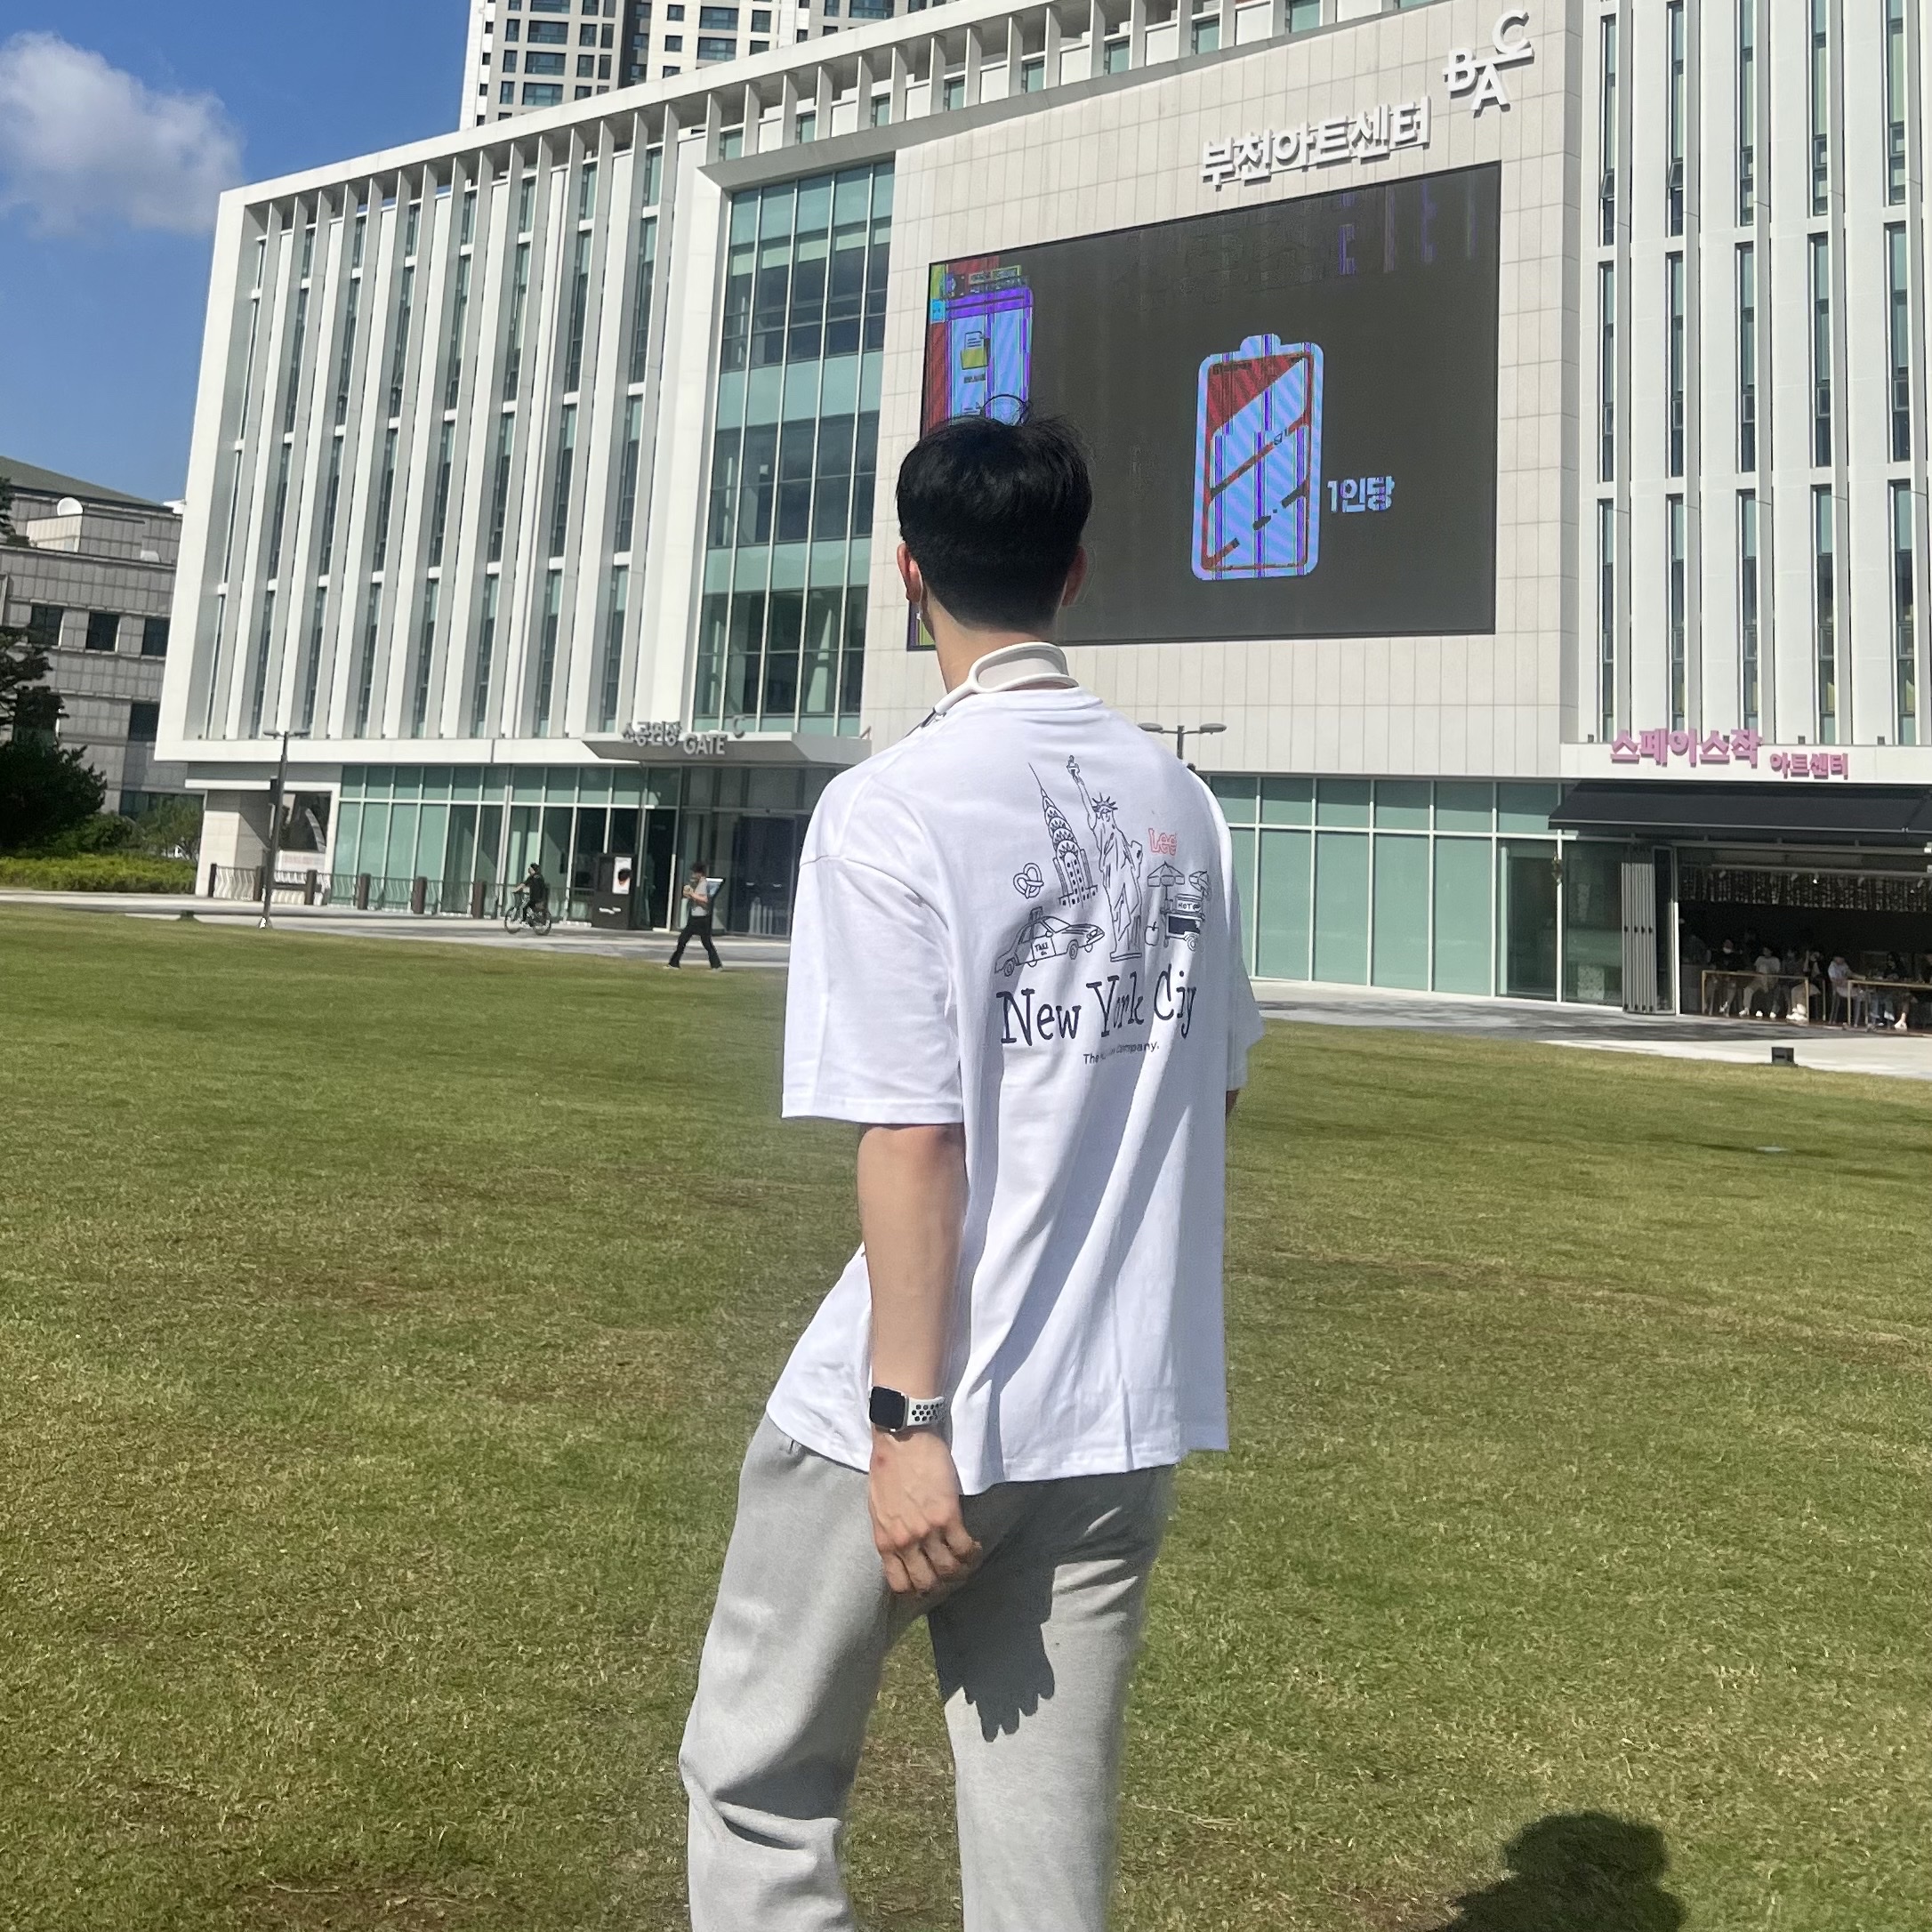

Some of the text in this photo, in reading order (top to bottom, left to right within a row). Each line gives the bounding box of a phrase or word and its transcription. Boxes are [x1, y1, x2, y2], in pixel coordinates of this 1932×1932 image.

[1201, 96, 1431, 190] 부천아트센터
[1327, 476, 1395, 512] 1인당
[683, 734, 727, 754] GATE
[732, 715, 745, 739] C
[1610, 728, 1848, 779] 스페이스작 아트센터
[1148, 828, 1178, 856] Lee
[996, 988, 1082, 1046] New
[1153, 963, 1197, 1040] Ciy
[1083, 1052, 1099, 1065] The
